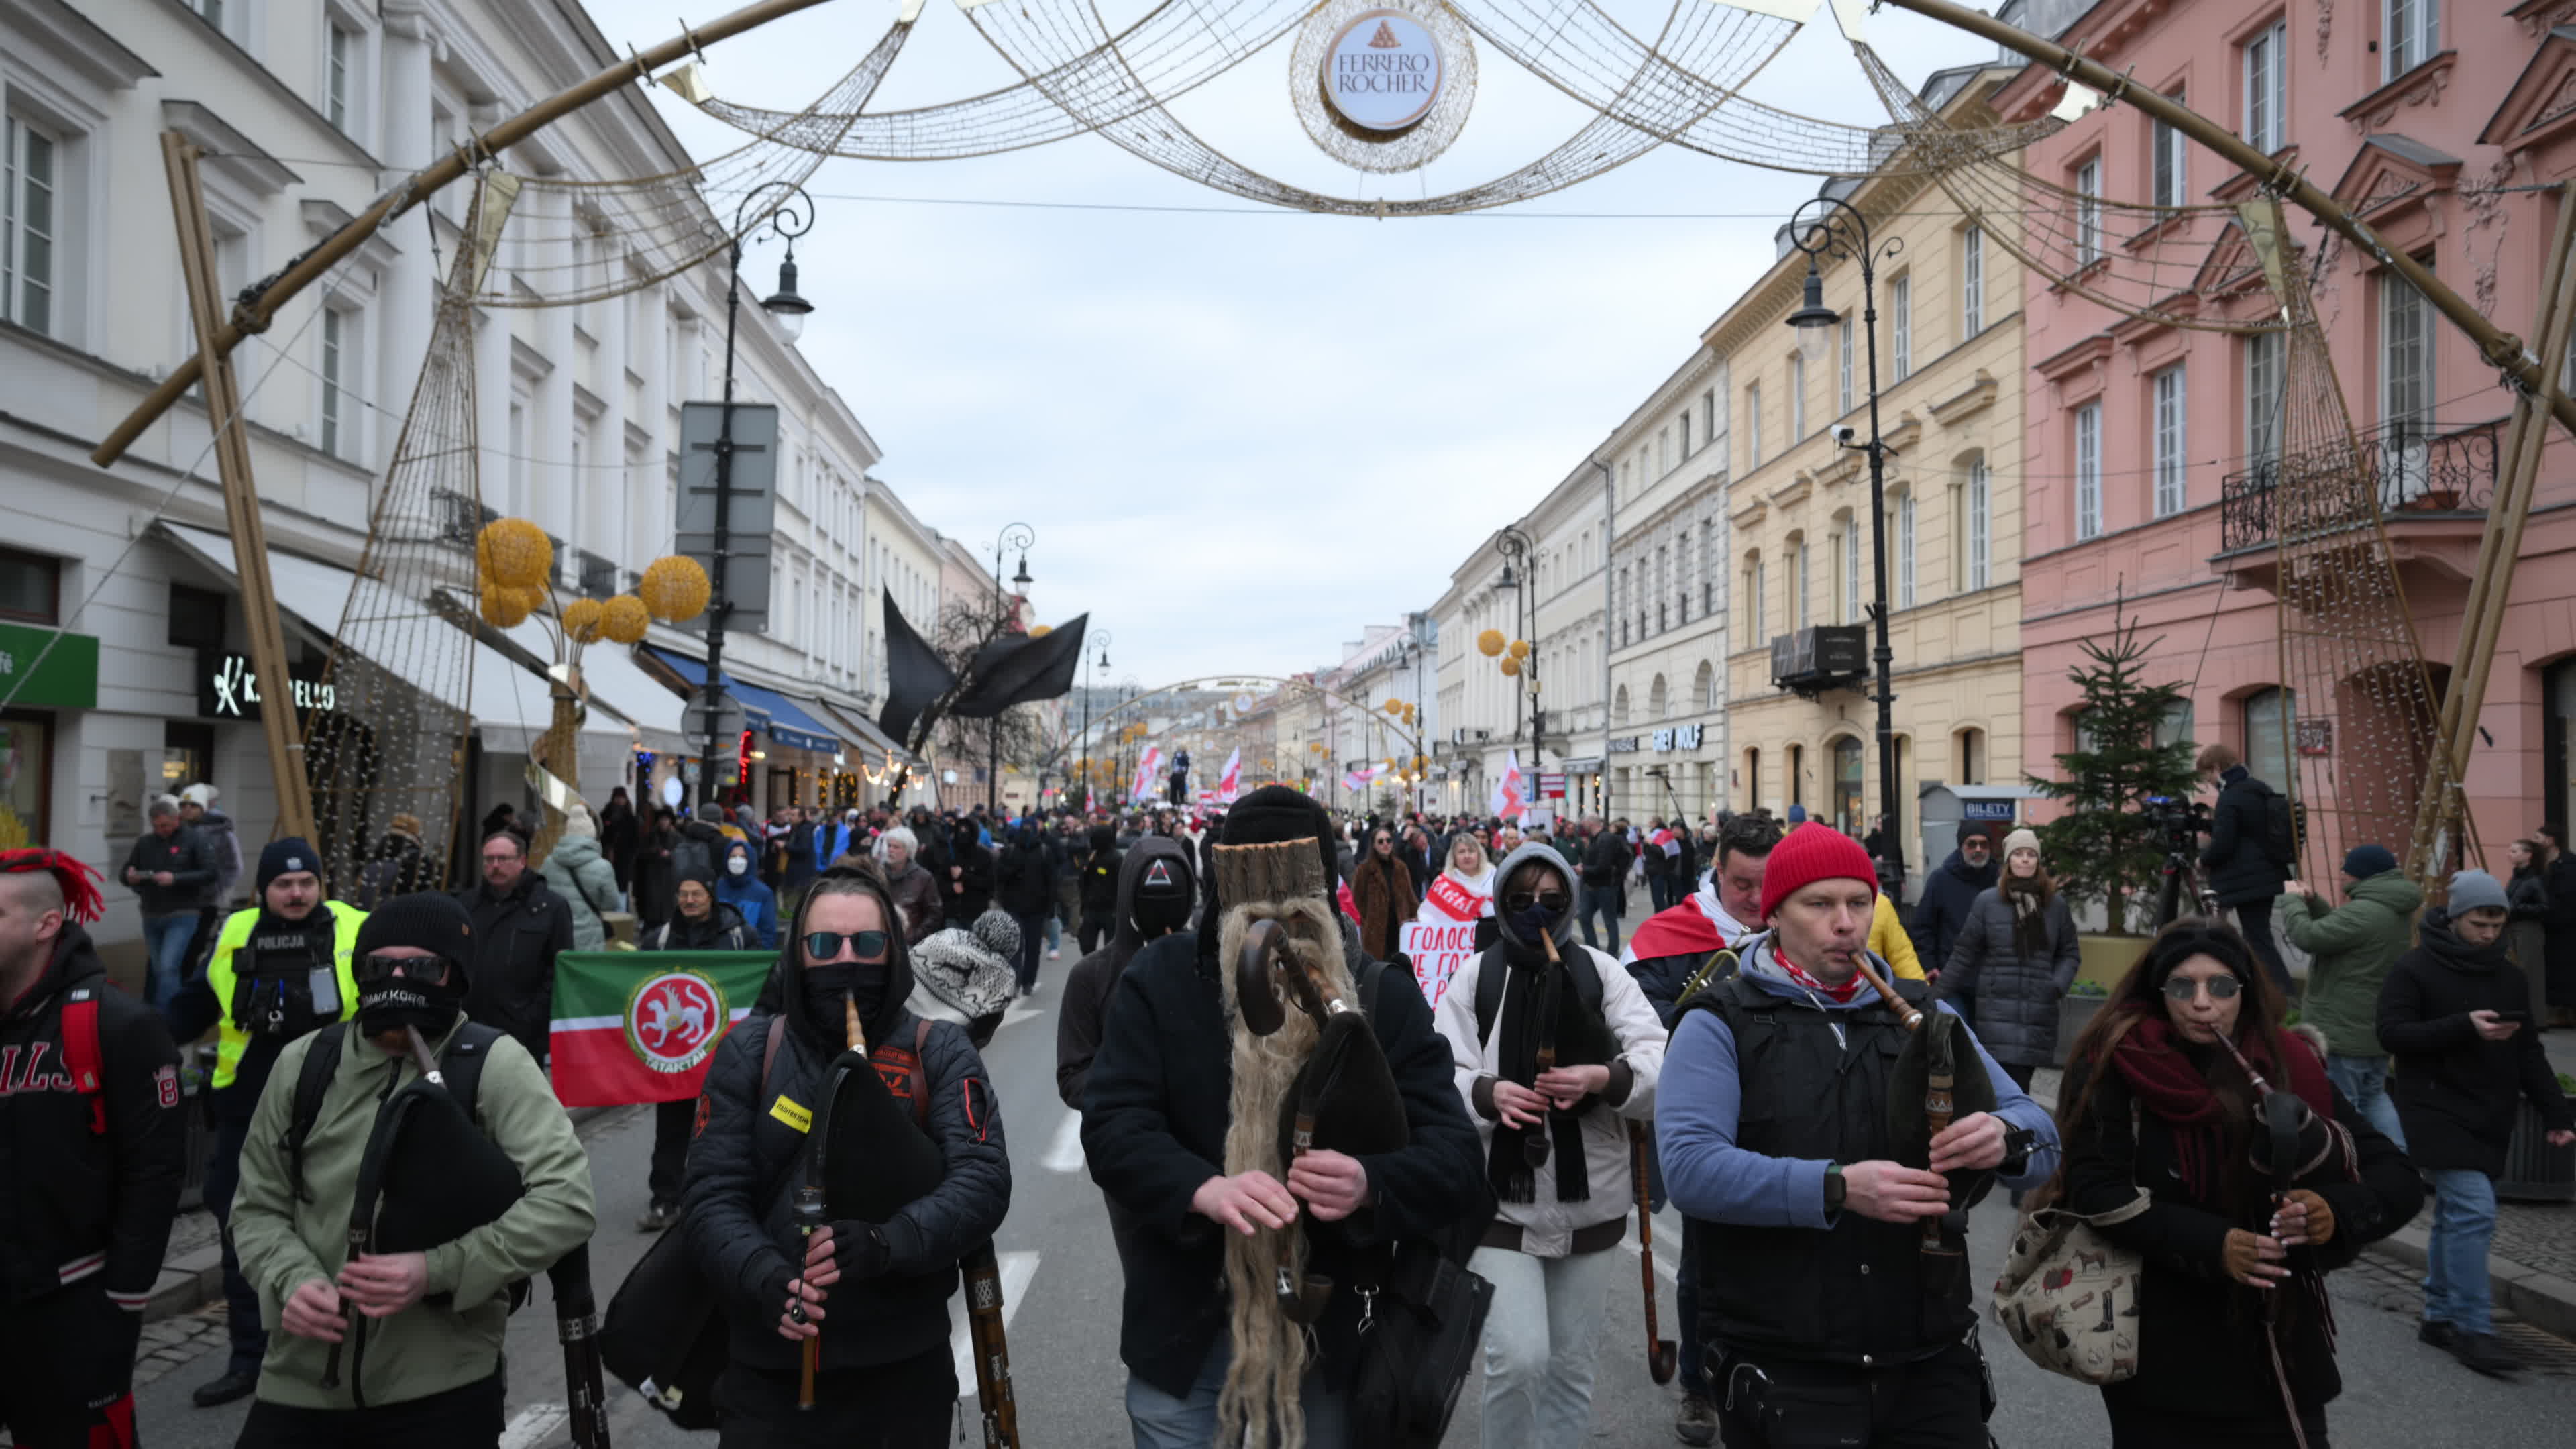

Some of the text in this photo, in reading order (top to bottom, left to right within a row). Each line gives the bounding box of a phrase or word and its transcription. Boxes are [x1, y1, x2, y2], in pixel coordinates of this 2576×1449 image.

[1339, 53, 1430, 72] FERRERO
[1339, 74, 1428, 93] ROCHER
[1652, 729, 1674, 752] GREY
[1677, 723, 1701, 750] WOLF
[1966, 803, 2010, 814] BILETY
[257, 934, 305, 950] POLICJA
[158, 1078, 178, 1109] 8
